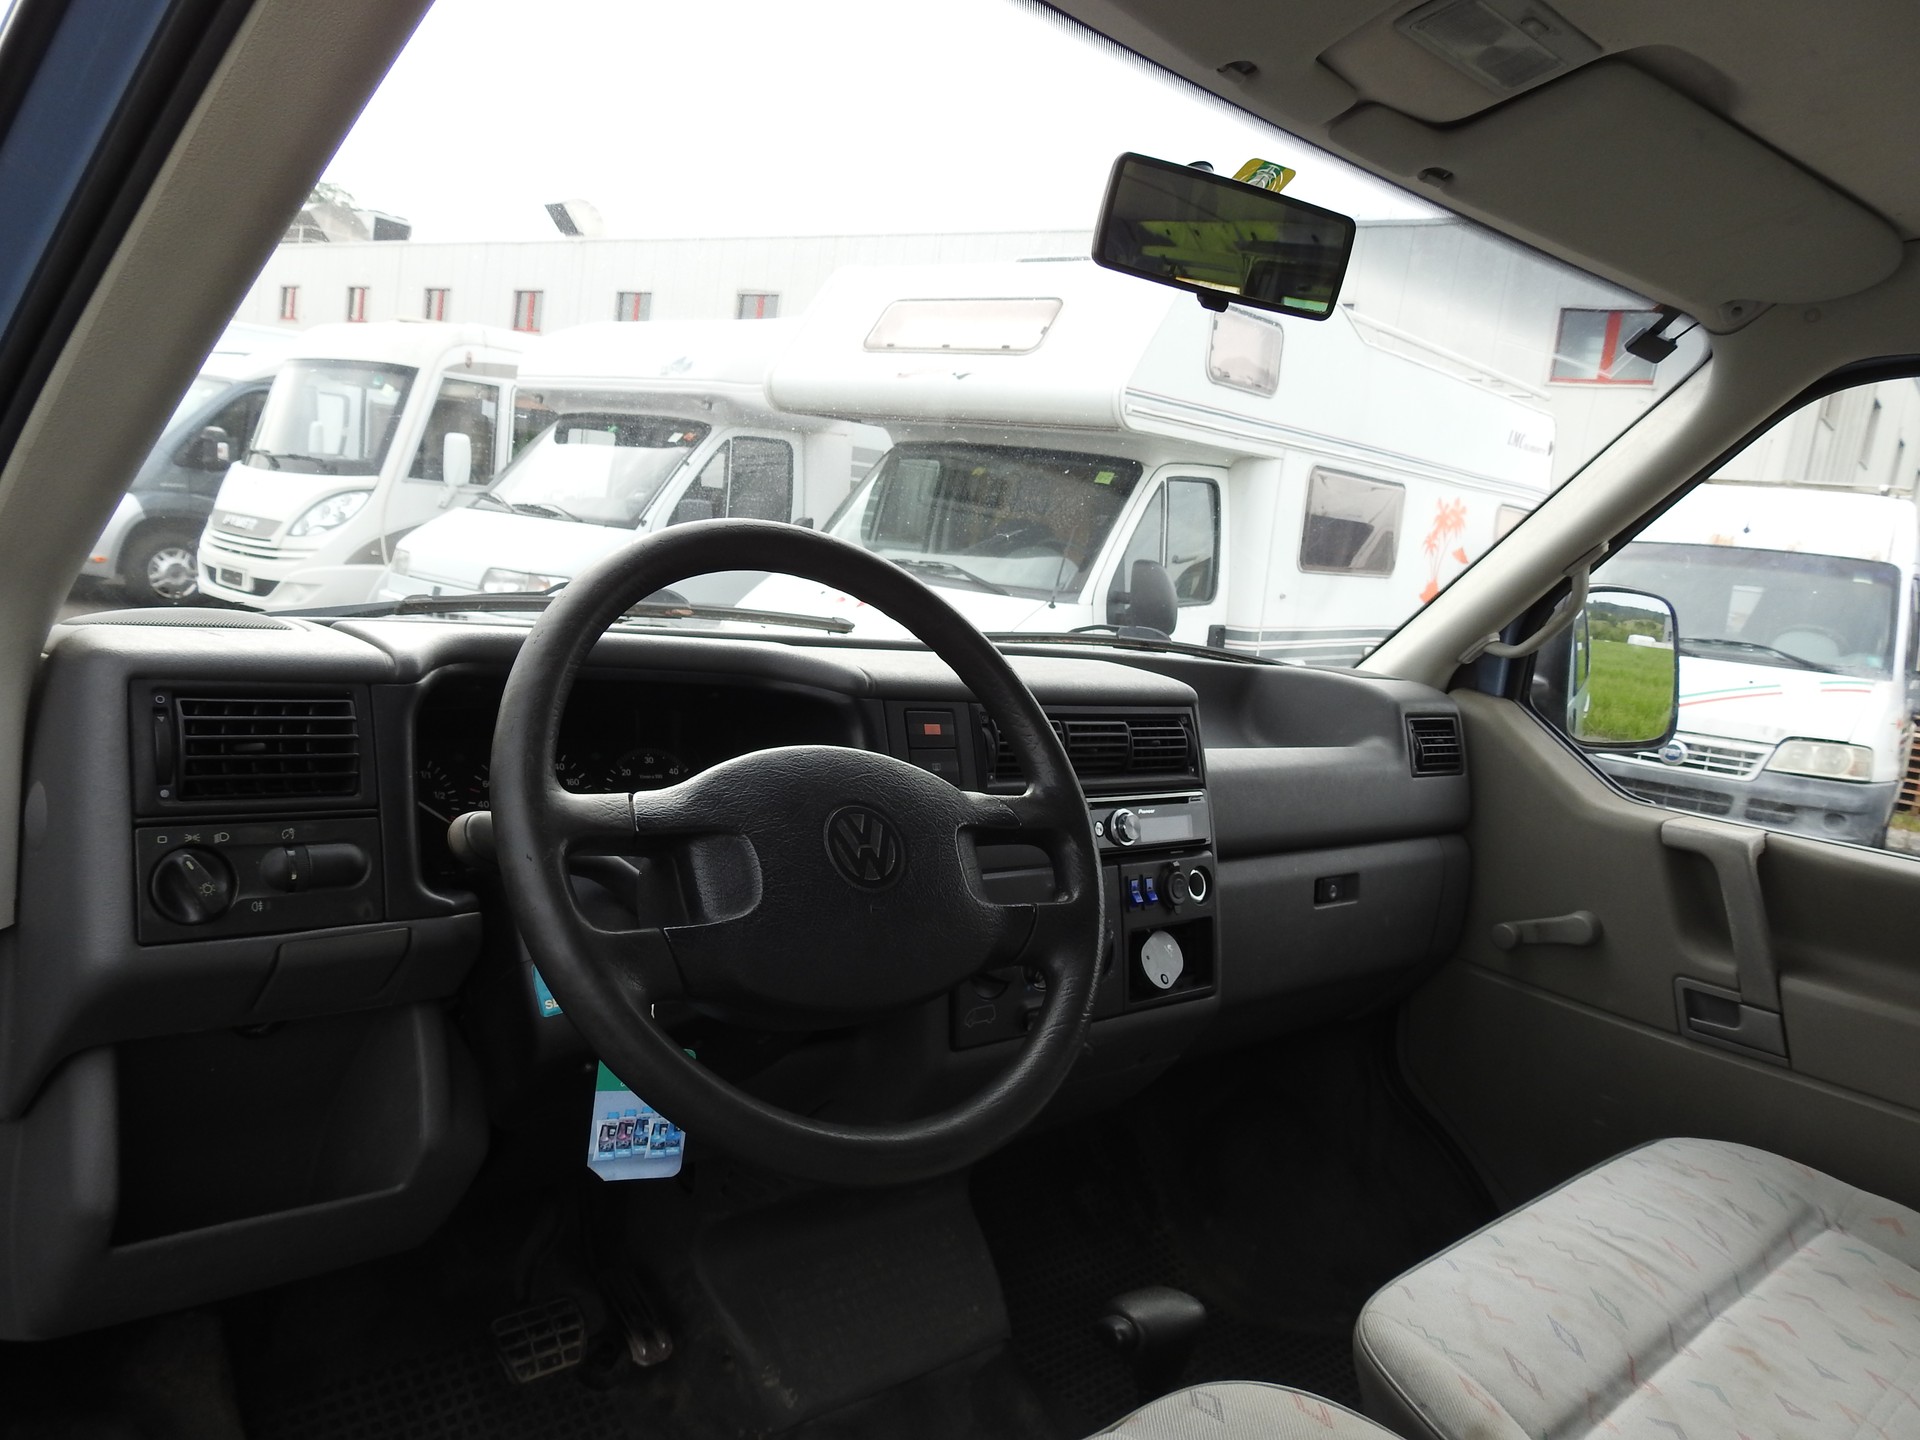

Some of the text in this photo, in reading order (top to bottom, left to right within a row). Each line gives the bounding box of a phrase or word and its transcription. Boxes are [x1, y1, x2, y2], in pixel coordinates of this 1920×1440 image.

[1507, 429, 1526, 449] LMC
[644, 756, 654, 764] 30
[621, 768, 631, 776] 20
[668, 767, 679, 775] 40
[566, 778, 580, 786] 160
[478, 800, 490, 808] 40
